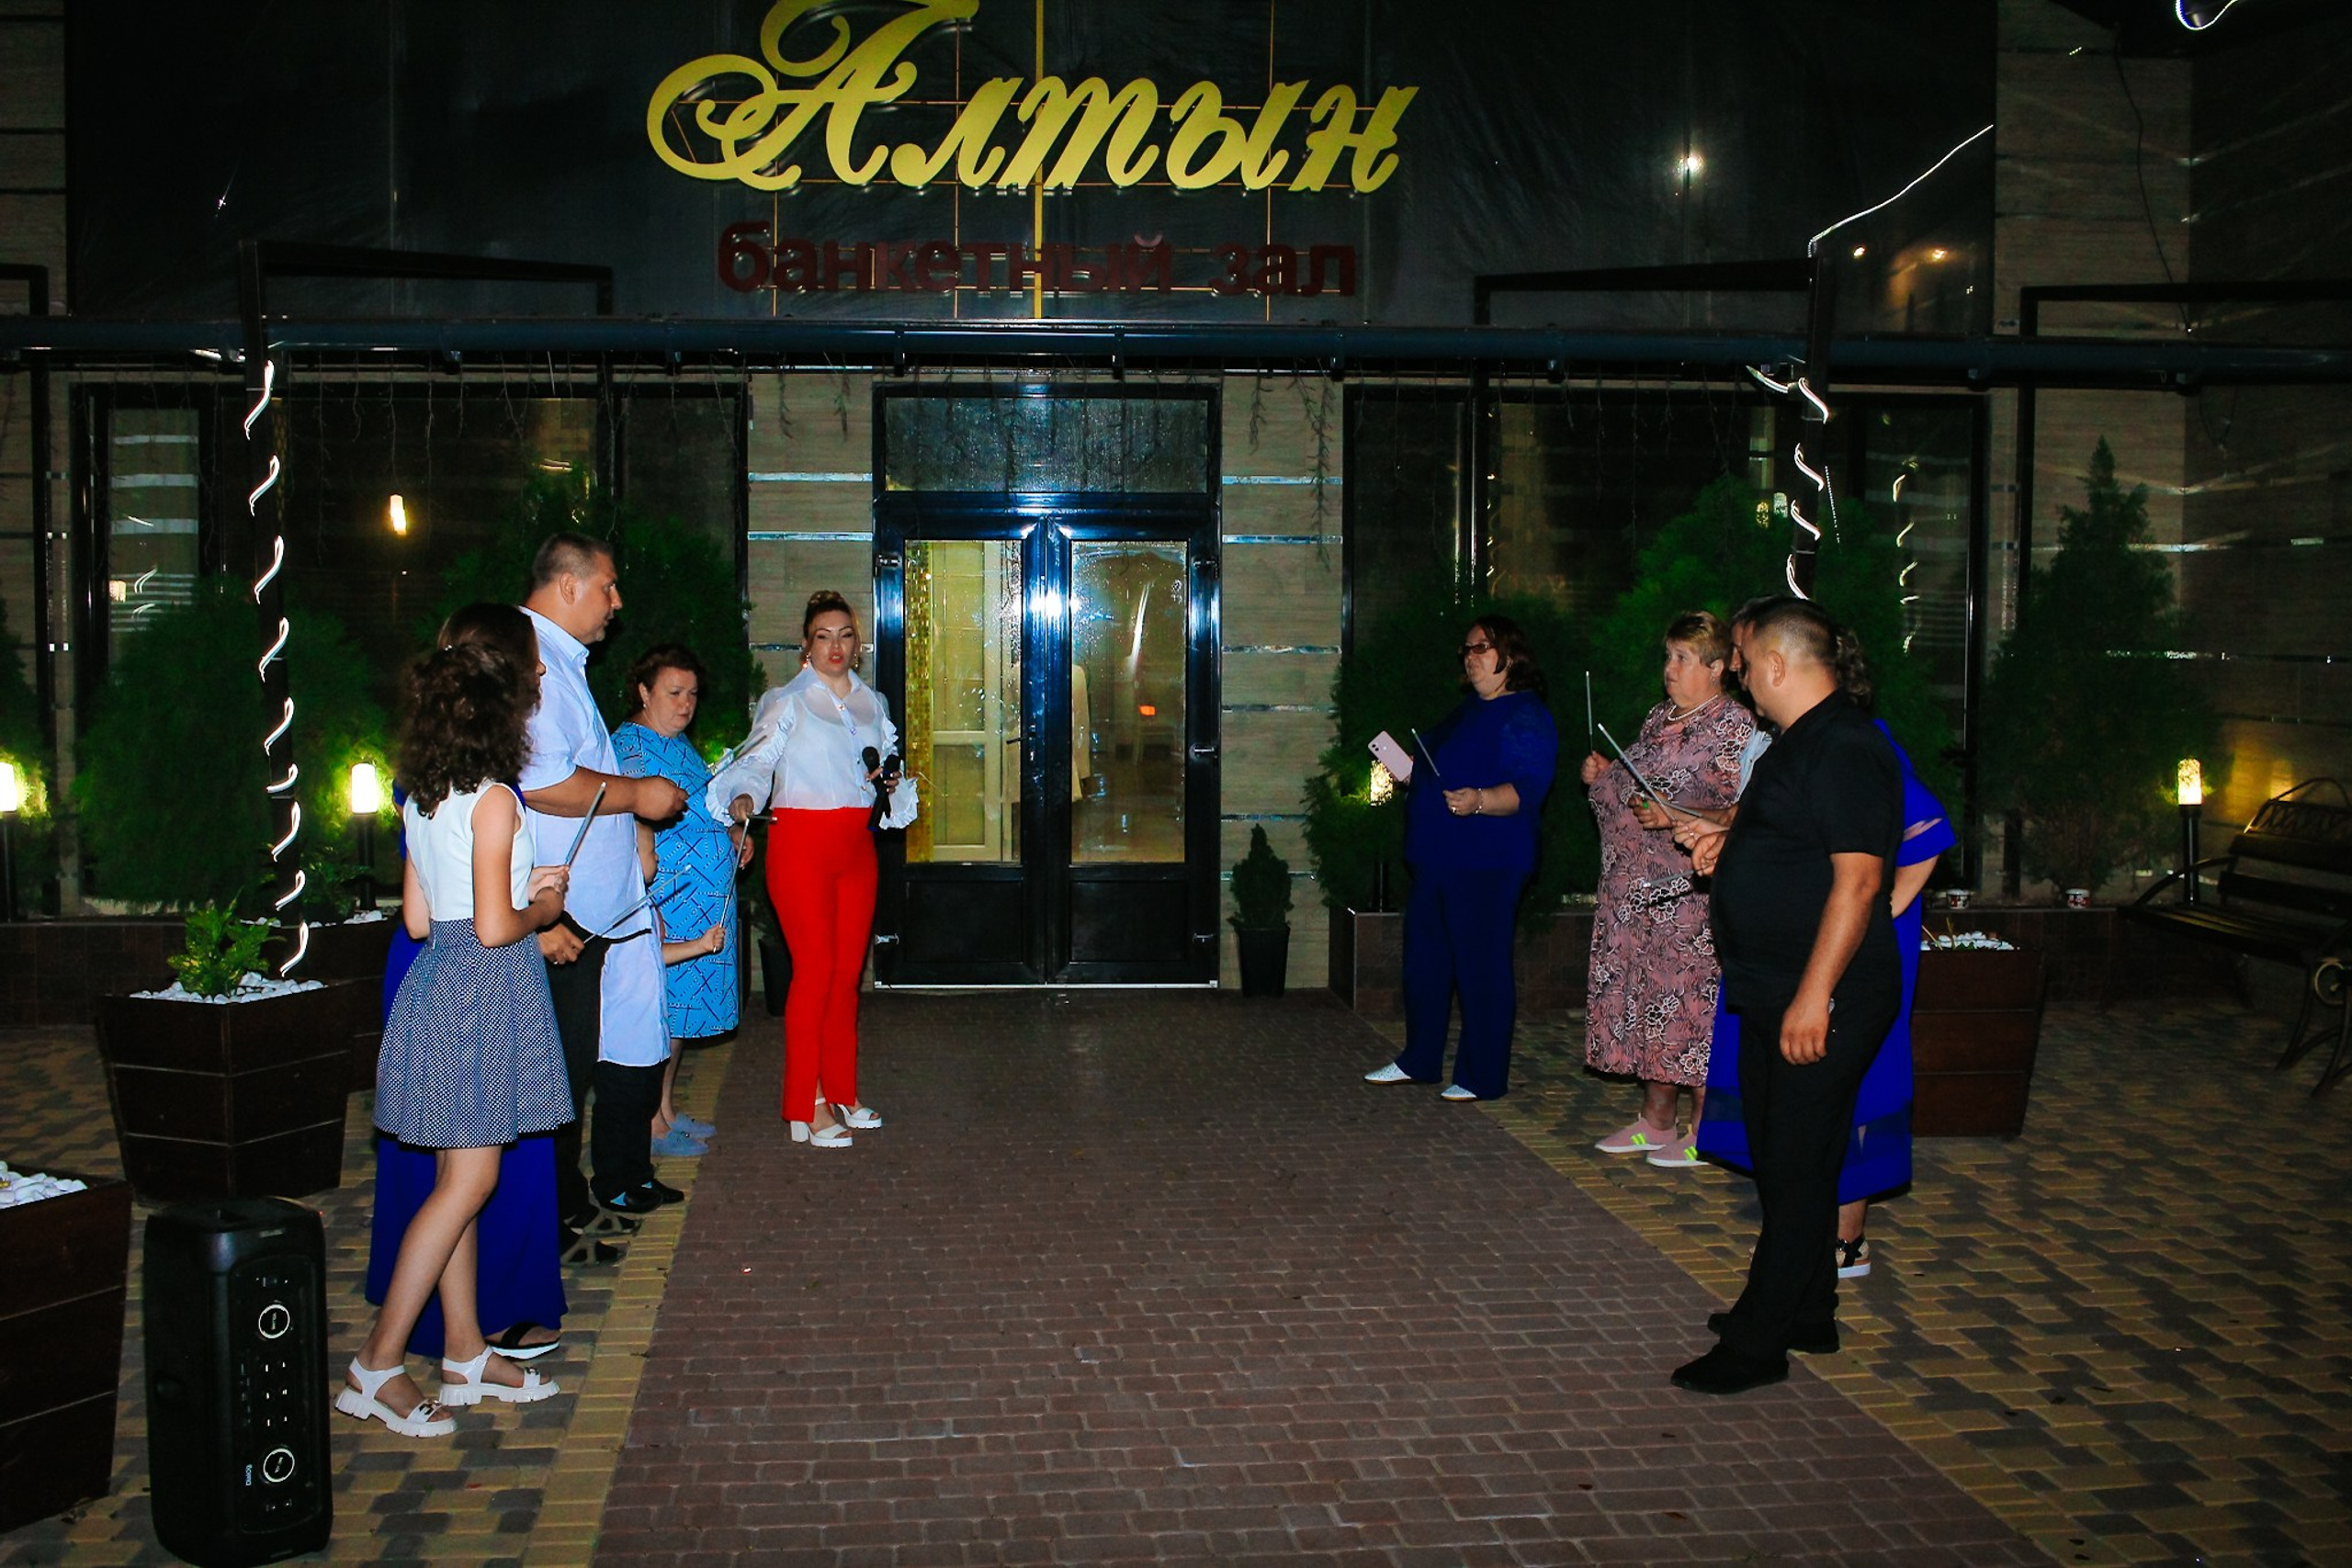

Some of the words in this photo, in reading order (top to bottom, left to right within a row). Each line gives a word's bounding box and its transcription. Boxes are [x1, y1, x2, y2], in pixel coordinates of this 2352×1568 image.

[647, 0, 1419, 191] Алтын
[718, 221, 1172, 295] банкетный
[1209, 243, 1357, 297] зал
